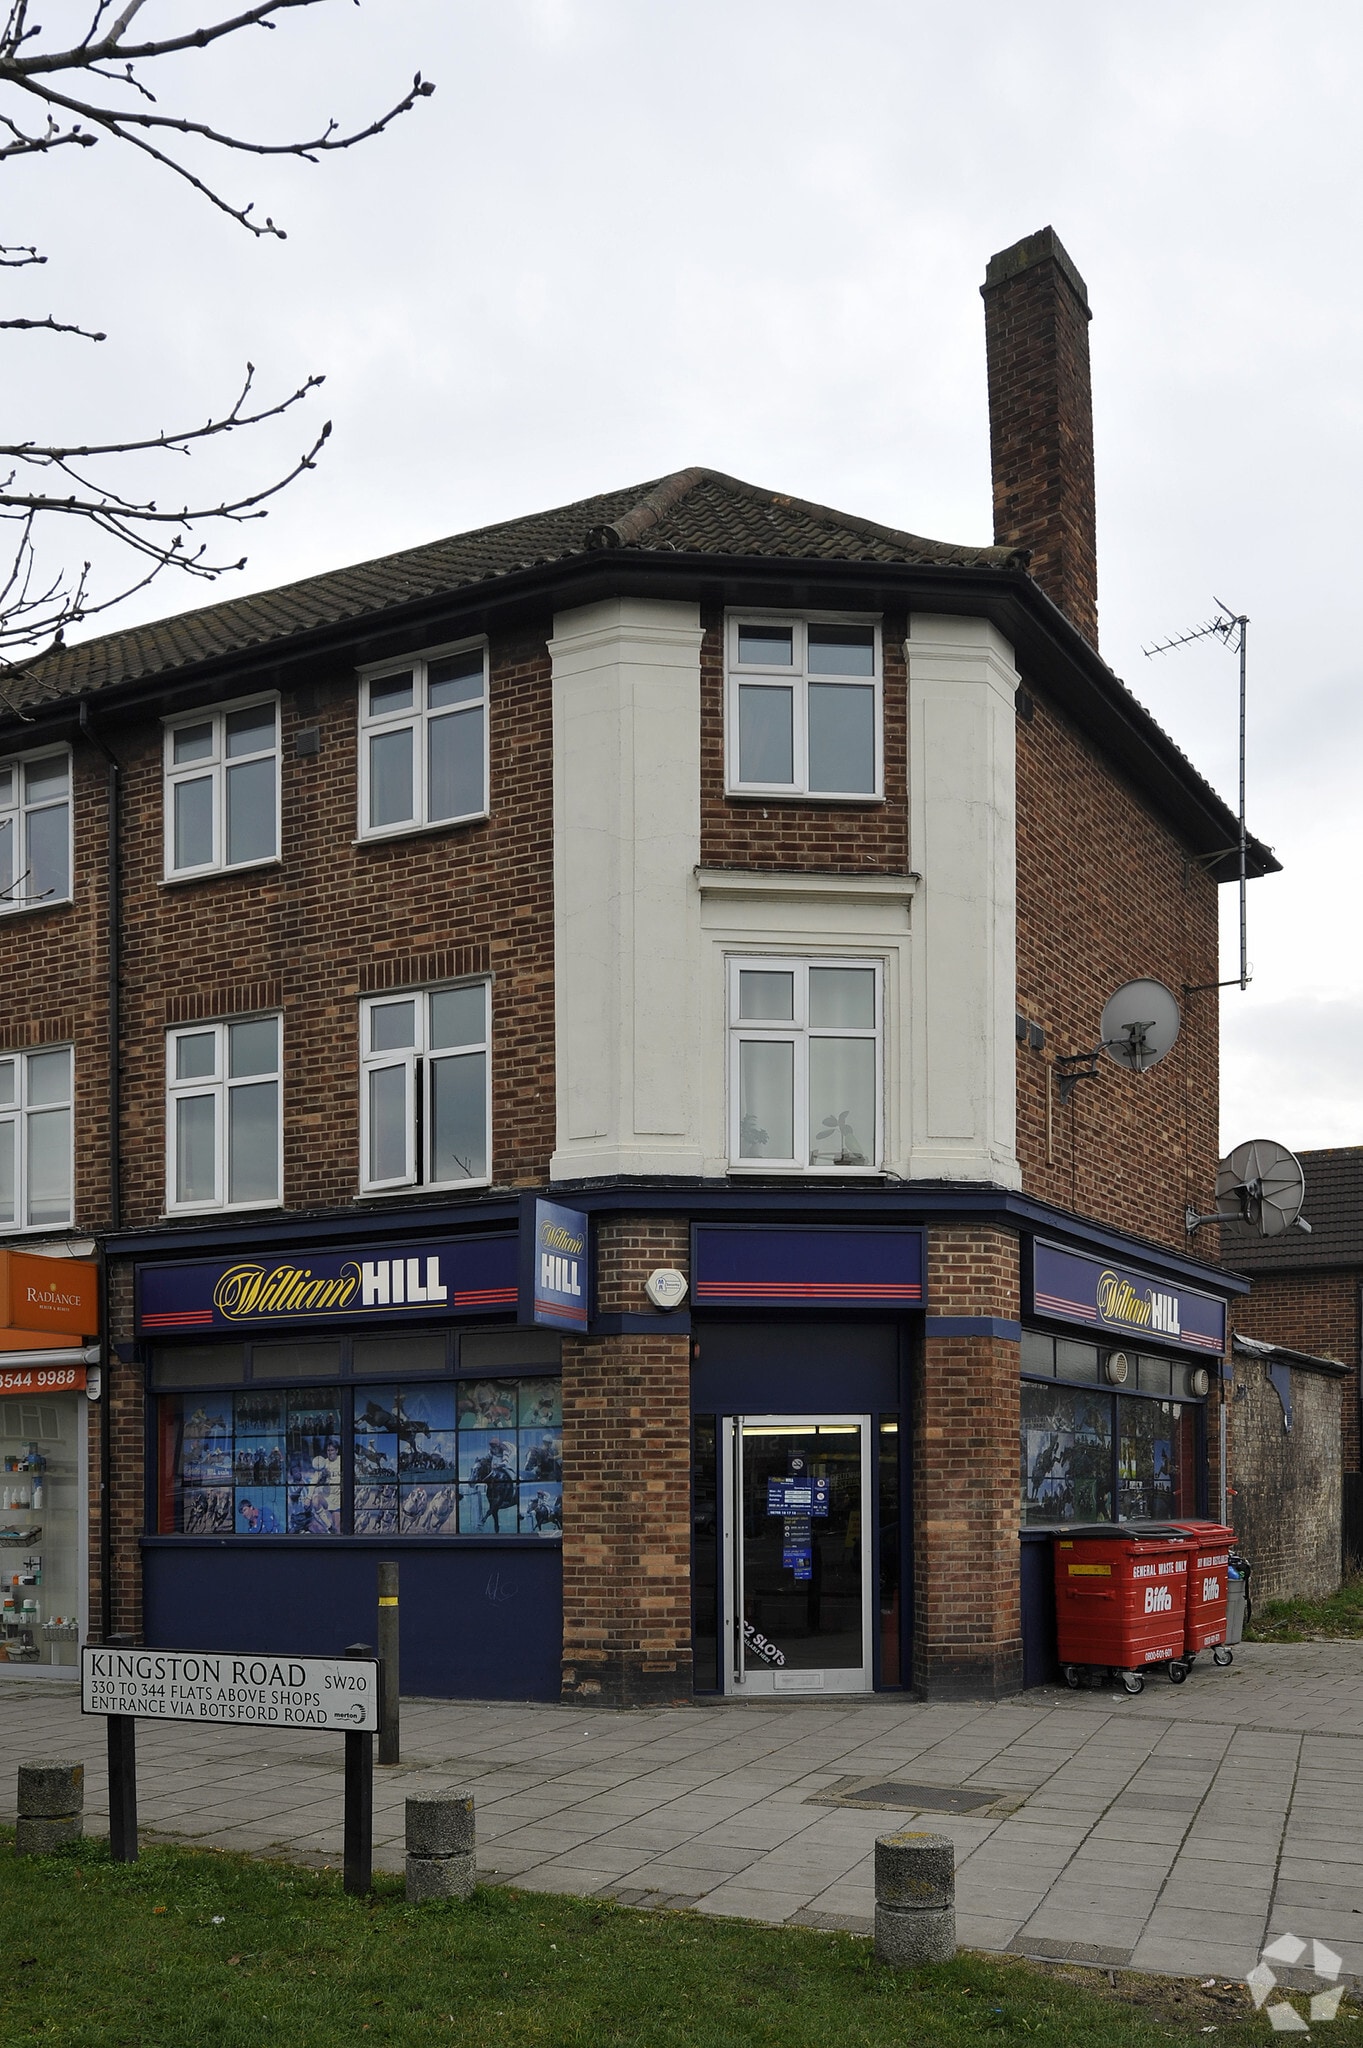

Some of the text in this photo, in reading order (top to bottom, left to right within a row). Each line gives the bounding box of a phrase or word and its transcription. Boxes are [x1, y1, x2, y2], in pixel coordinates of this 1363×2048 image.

[540, 1220, 584, 1255] William
[214, 1256, 448, 1316] William HILL
[541, 1252, 581, 1296] HILL
[26, 1287, 81, 1306] RADIANCE
[1096, 1270, 1180, 1334] William HILL
[37, 1369, 76, 1386] 9988
[1133, 1560, 1187, 1578] GENERAL WASTE ONLY
[1144, 1586, 1172, 1614] Biffa
[1203, 1576, 1220, 1602] Biffa
[752, 1634, 785, 1666] SLOTS
[91, 1654, 367, 1691] KINGSTON ROAD SW20
[91, 1680, 320, 1707] 330 TO 344 FLATS ABOVE SHOPS
[91, 1695, 327, 1724] ENTRANCE VIA BOTSFORD ROAD
